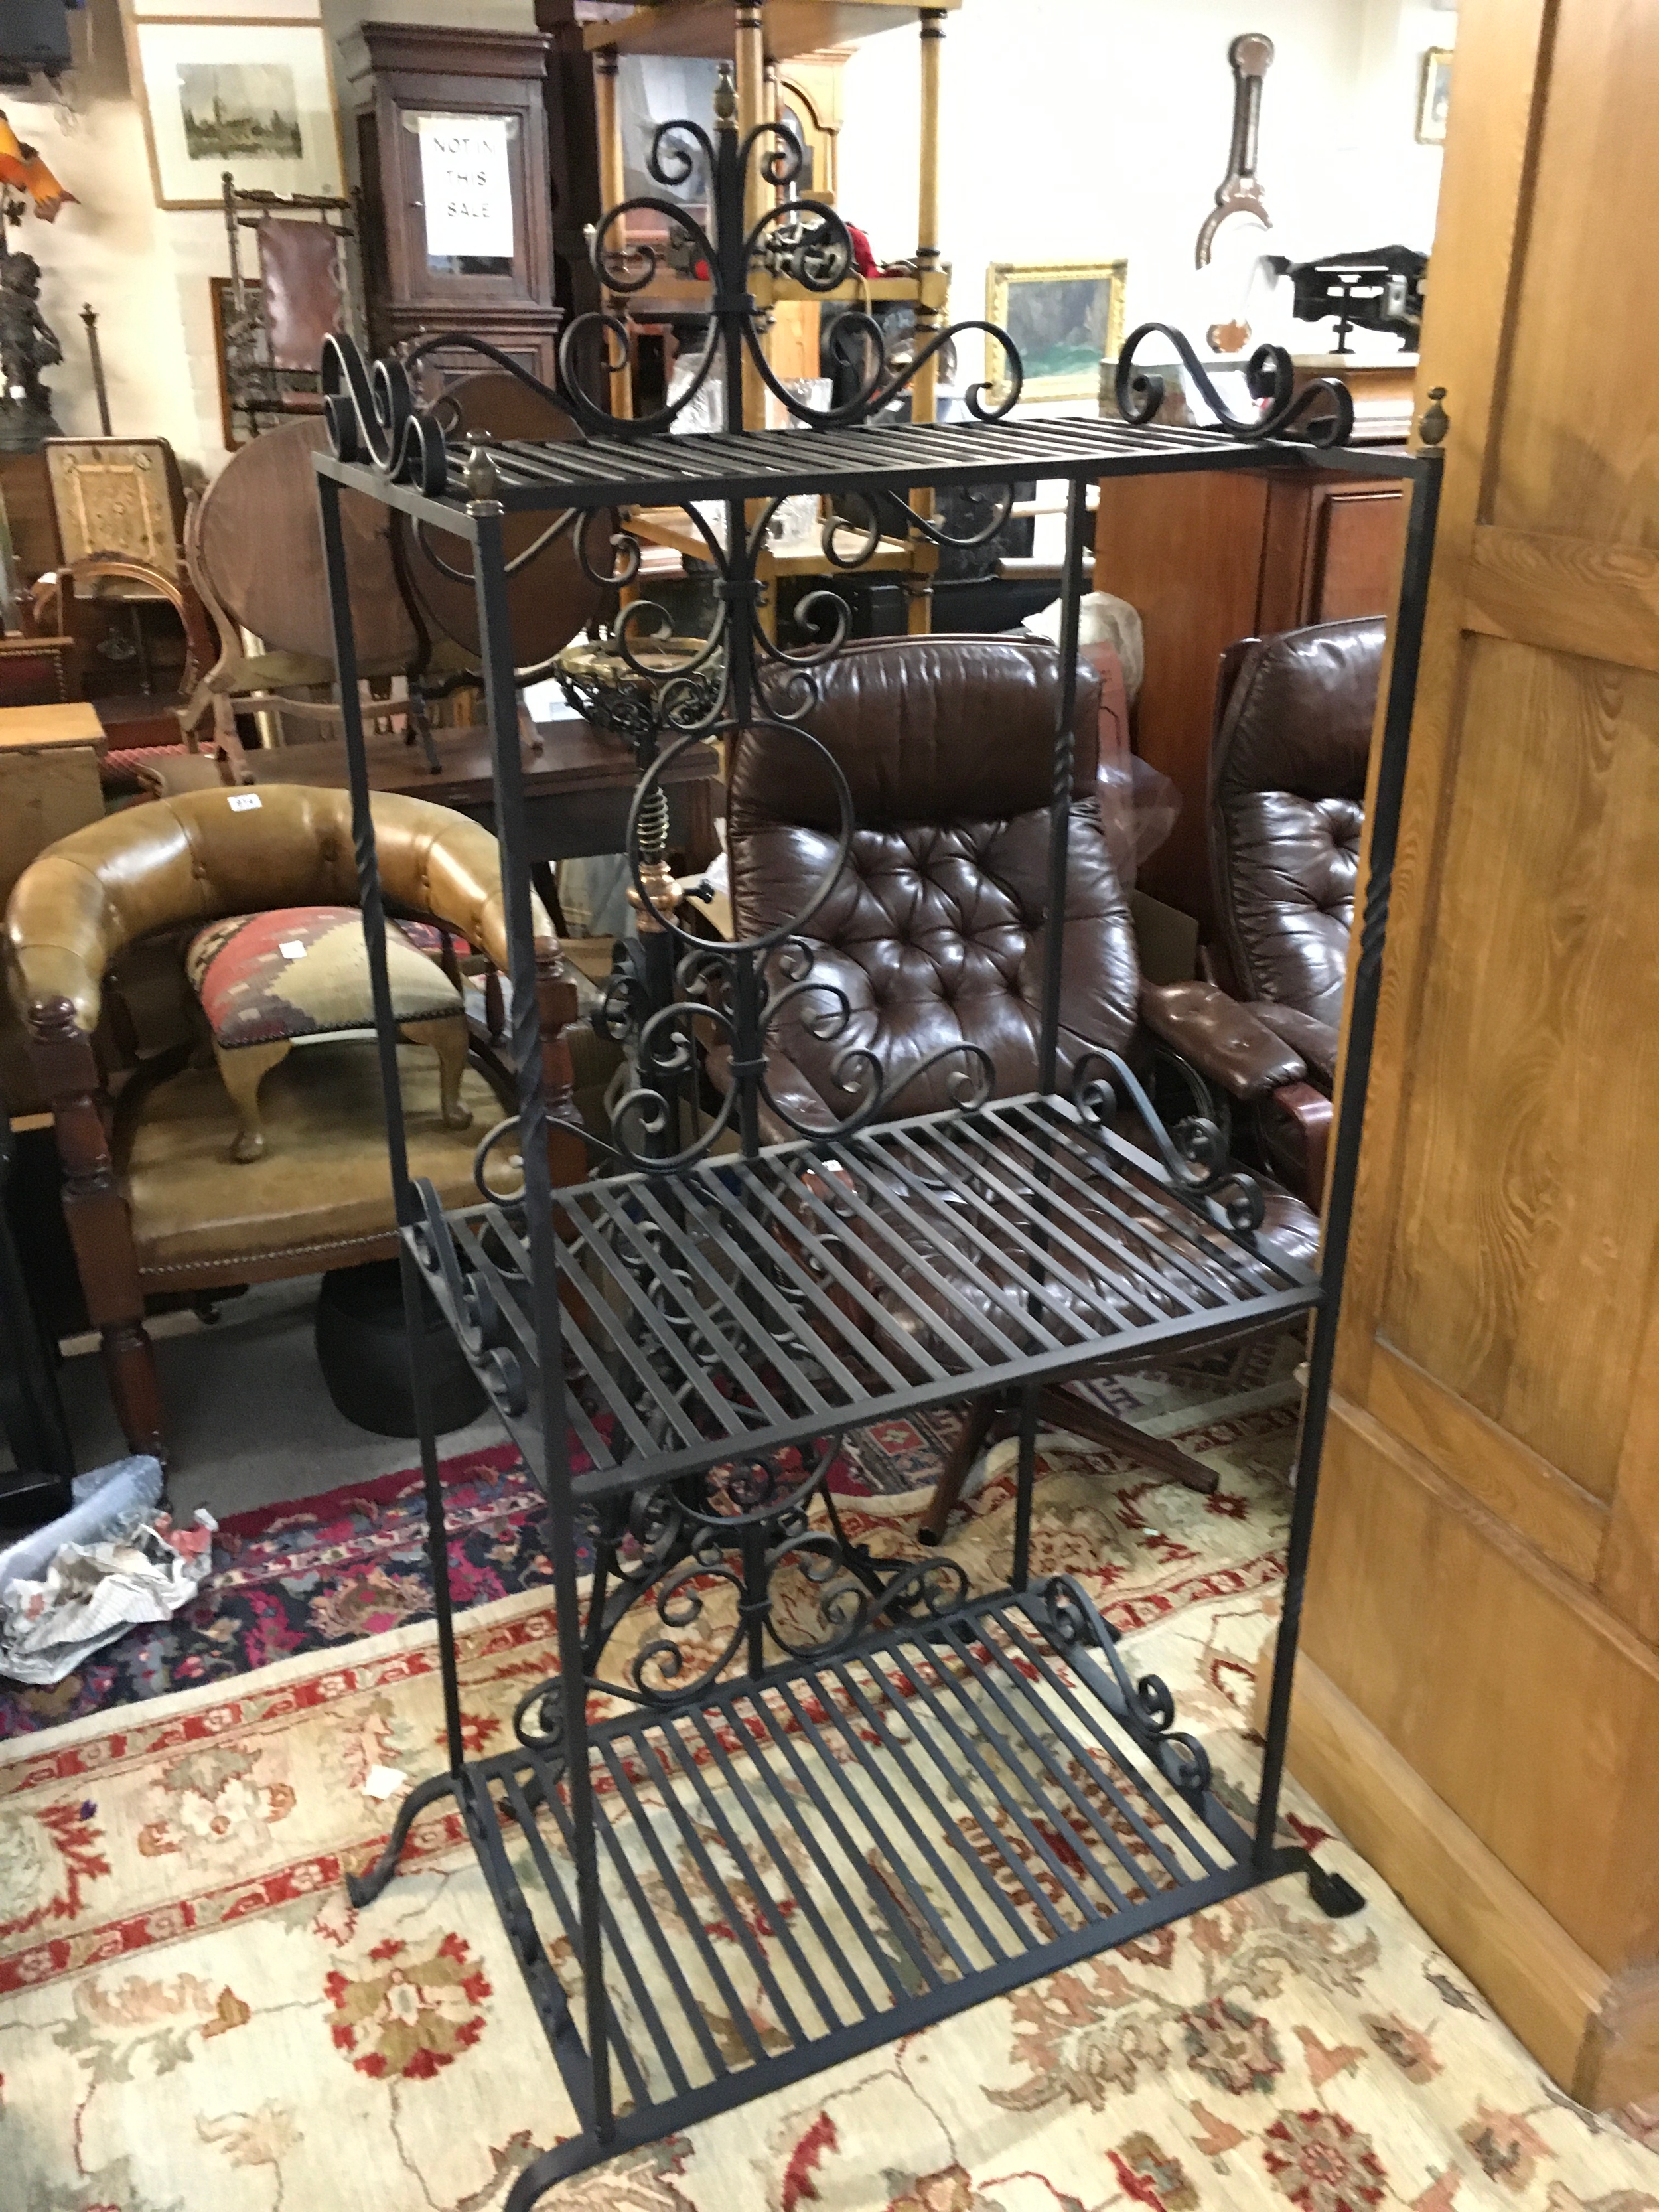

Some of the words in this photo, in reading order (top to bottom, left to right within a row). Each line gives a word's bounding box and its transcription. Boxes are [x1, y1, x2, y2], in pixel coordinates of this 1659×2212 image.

[433, 137, 470, 155] NOT
[476, 139, 496, 155] IN
[446, 169, 487, 186] THIS
[447, 202, 490, 218] SALE
